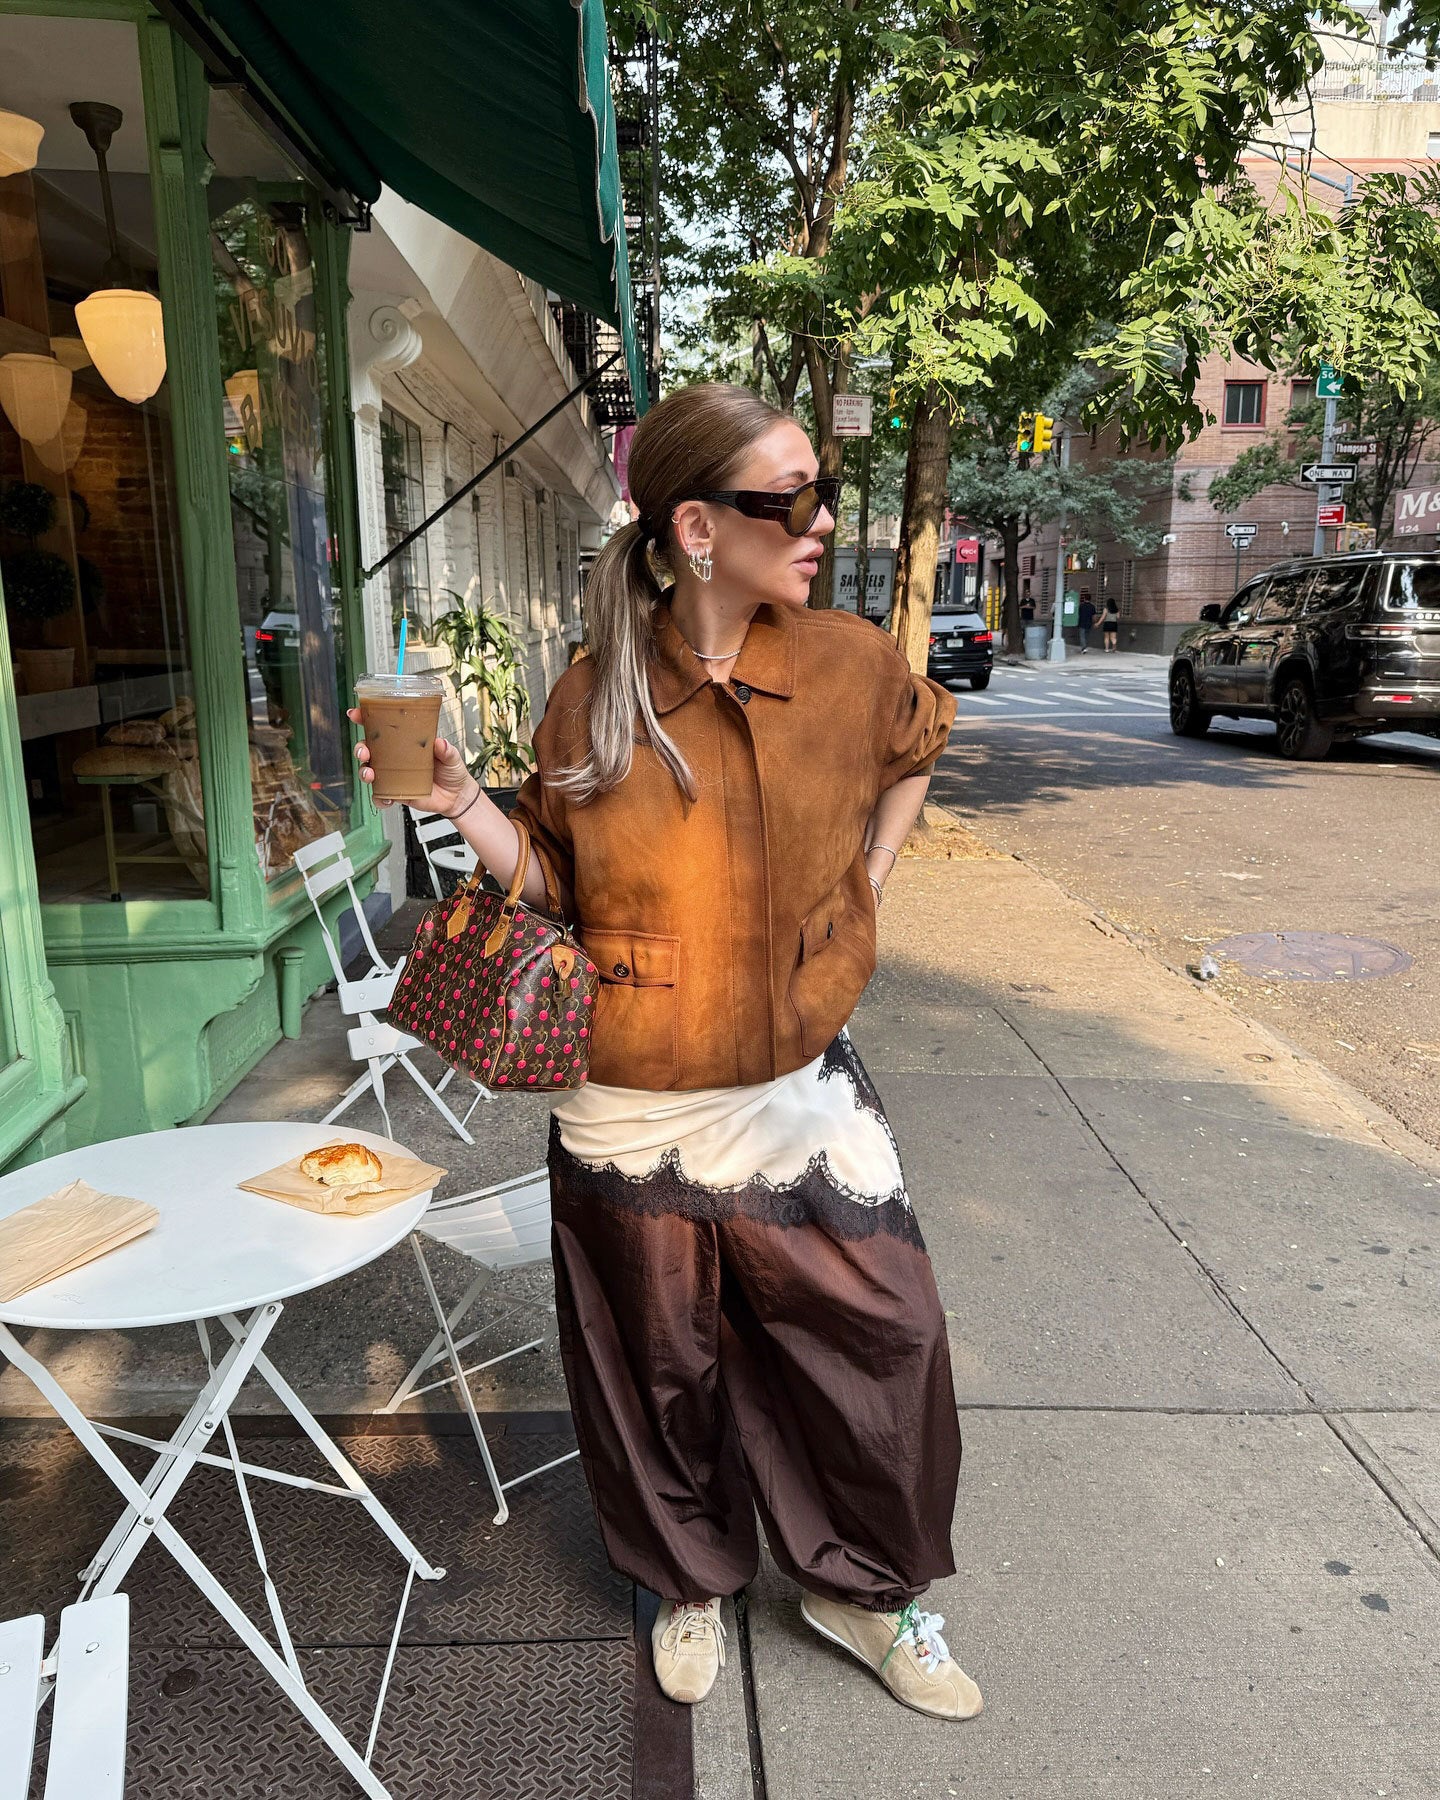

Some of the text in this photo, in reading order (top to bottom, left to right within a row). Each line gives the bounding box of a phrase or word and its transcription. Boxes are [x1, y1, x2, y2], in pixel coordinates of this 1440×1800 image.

[229, 287, 319, 395] VESUVIO
[240, 373, 321, 475] BAKERY
[1336, 443, 1377, 455] Thompson St
[1309, 470, 1325, 478] ONE
[1399, 524, 1419, 534] 124
[840, 574, 886, 588] SAELS
